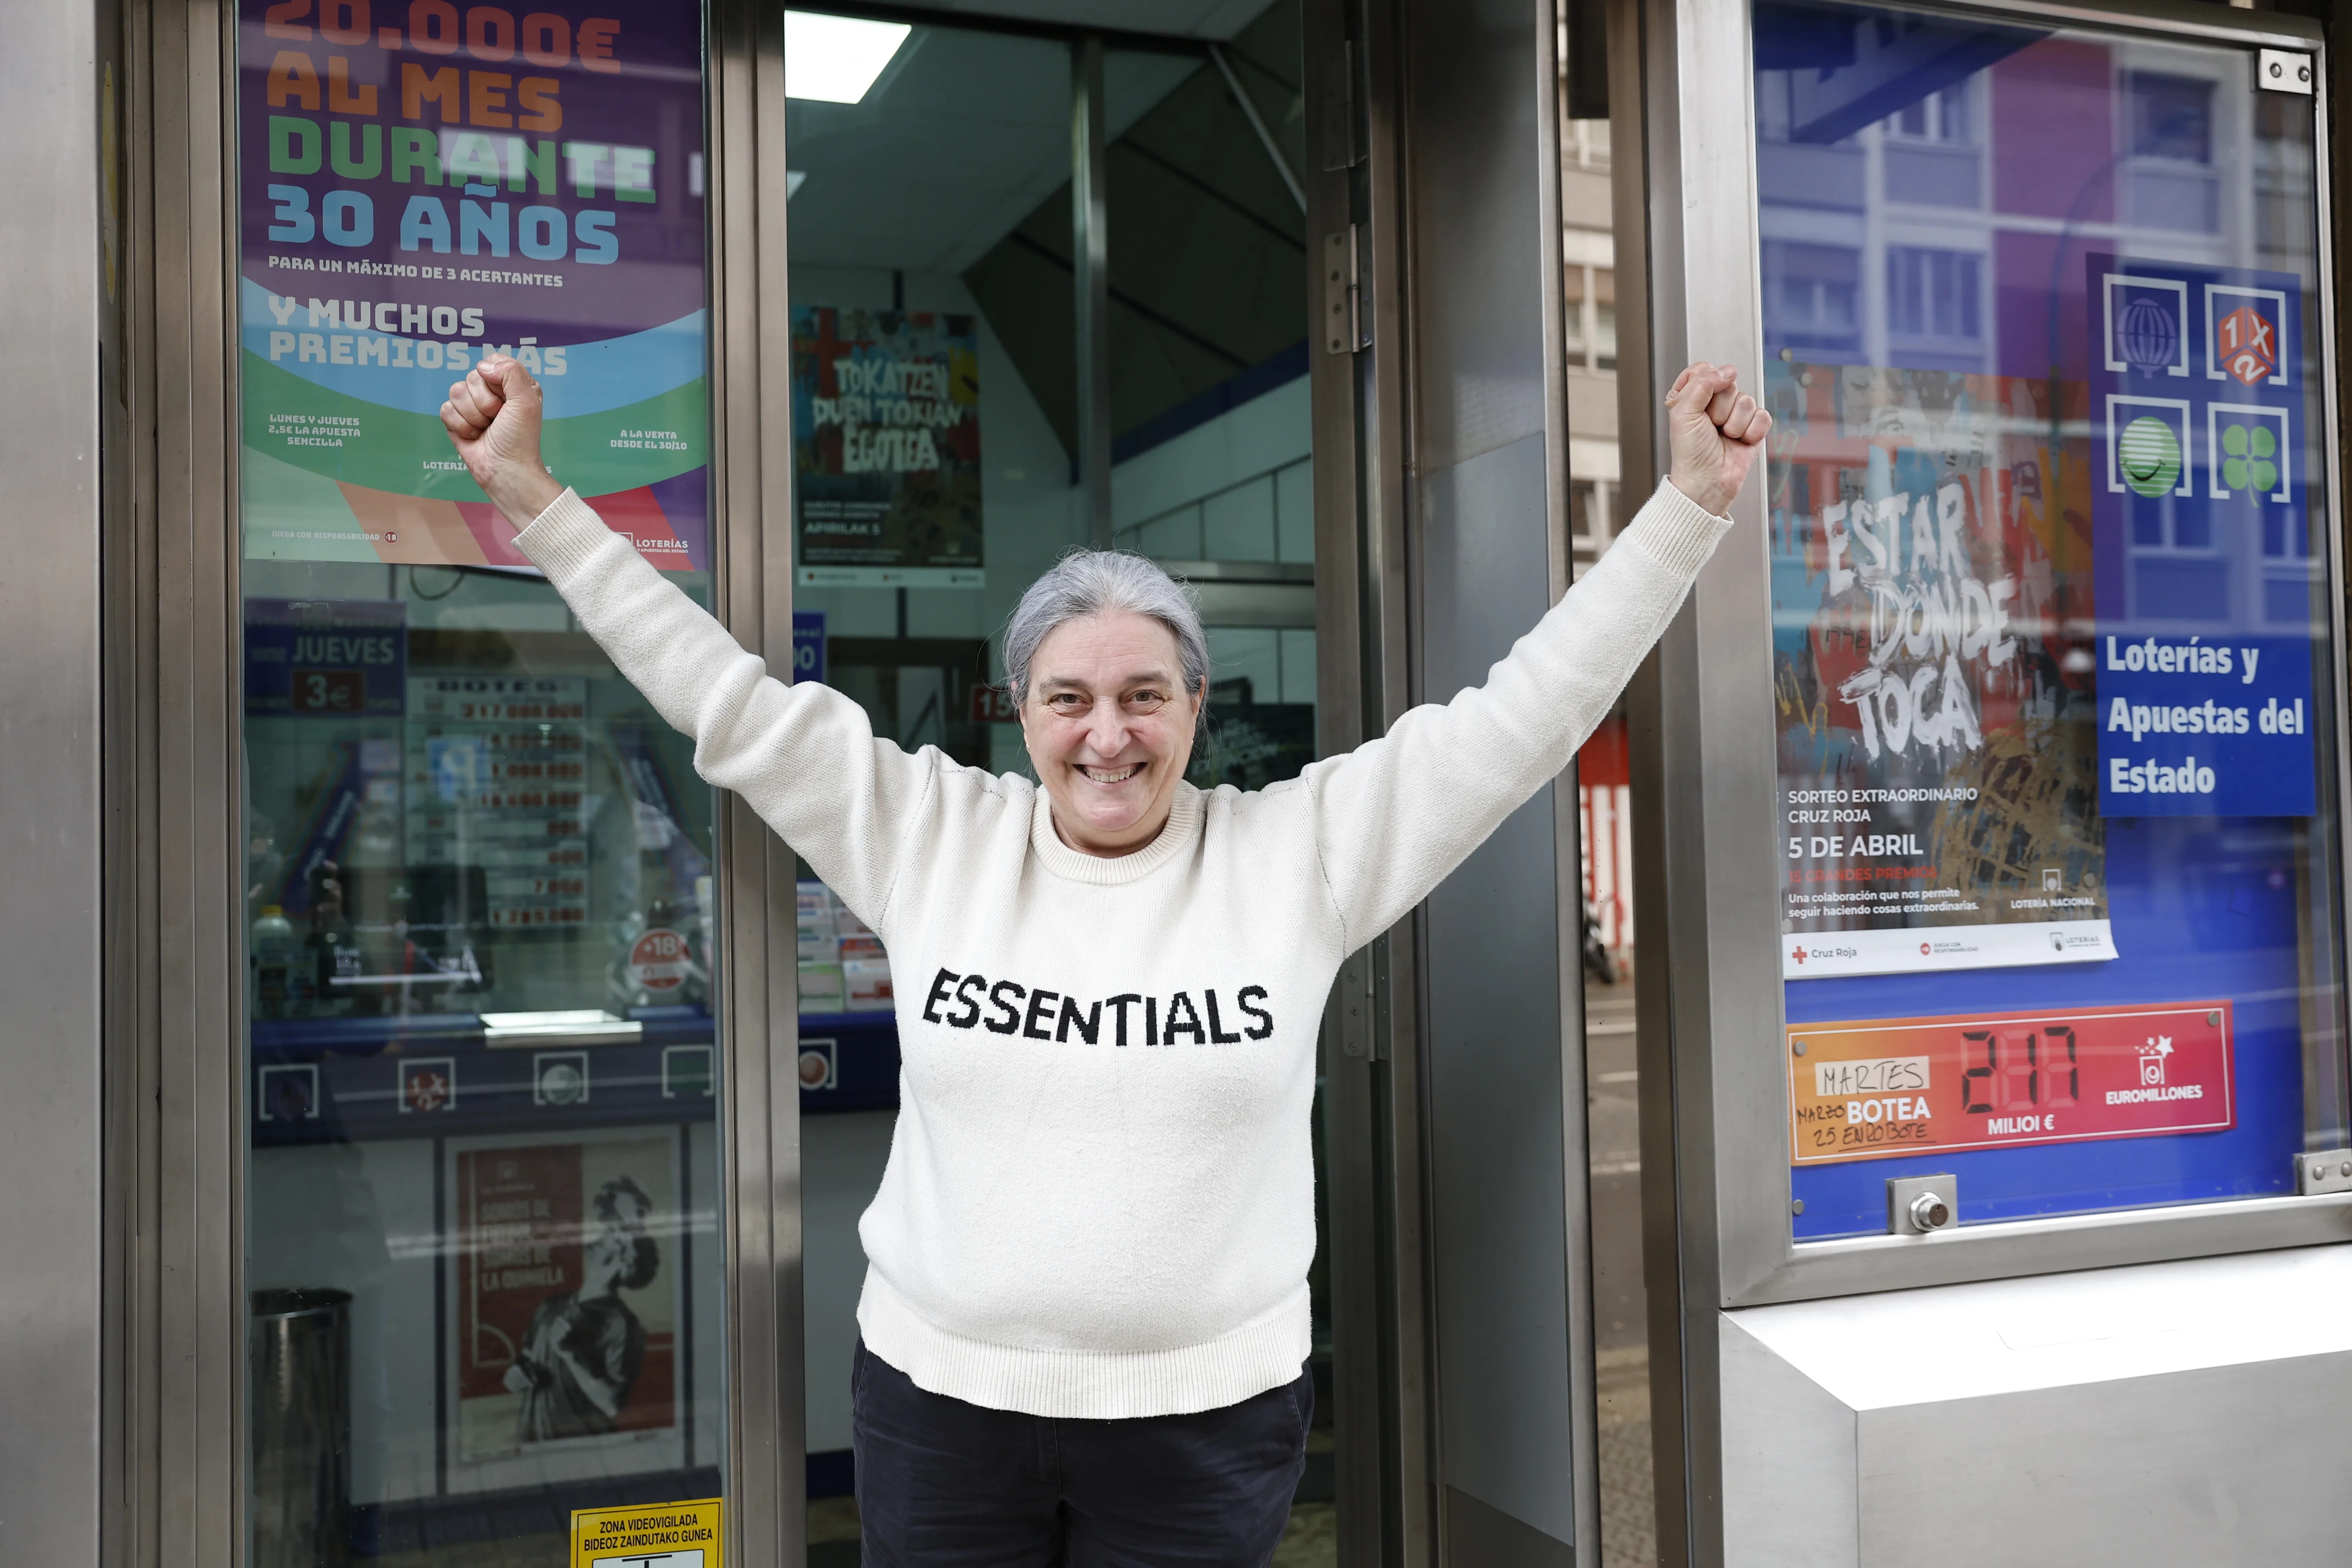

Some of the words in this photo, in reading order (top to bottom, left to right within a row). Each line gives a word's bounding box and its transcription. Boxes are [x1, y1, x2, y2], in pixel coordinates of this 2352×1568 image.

[267, 50, 378, 116] AL
[401, 62, 563, 133] MES
[269, 115, 656, 204] DURANTE
[268, 183, 374, 247] 30
[400, 183, 619, 265] AÑOS
[269, 255, 315, 271] PARA
[319, 259, 343, 273] UN
[347, 259, 418, 278] MÁXIMO
[422, 266, 443, 280] DE
[447, 268, 456, 281] 3
[460, 269, 563, 287] ACERTANTES
[269, 295, 296, 326] Y
[308, 298, 485, 337] MUCHOS
[269, 330, 470, 371] PREMIOS
[269, 425, 293, 434] 2,5€
[295, 426, 310, 435] LA
[312, 426, 361, 437] APUESTA
[270, 414, 306, 423] LUNES
[318, 416, 359, 426] JUEVES
[287, 437, 343, 447] SENCILLA
[610, 439, 643, 448] DESDE
[659, 441, 688, 450] 30/10
[620, 430, 627, 438] A
[645, 431, 677, 439] VENTA
[314, 532, 379, 541] RESPONSABILIDAD
[636, 538, 688, 548] LOTERÍAS
[1821, 481, 1973, 598] ESTAR
[1860, 571, 2018, 667] DONDE
[292, 636, 395, 664] JUEVES
[2107, 635, 2233, 674] Loterías
[2241, 648, 2259, 684] y
[1838, 651, 1983, 760] TOCA
[2107, 697, 2250, 742] Apuestas
[2258, 697, 2304, 735] del
[2110, 756, 2216, 793] Estado
[1788, 790, 1848, 804] SORTEO
[1852, 787, 1978, 803] EXTRAORDINARIO
[1788, 811, 1830, 824] CRUZ
[1833, 809, 1871, 823] ROJA
[1788, 837, 1803, 859] 5
[1810, 837, 1843, 857] DE
[1850, 833, 1924, 857] ABRIL
[1789, 871, 1801, 883] 15
[1805, 868, 1873, 882] GRANDES
[1876, 866, 1938, 880] PREMIOS
[1789, 894, 1809, 903] Una
[1811, 891, 1877, 902] colaboración
[1879, 891, 1899, 902] que
[1901, 889, 1920, 899] nos
[1922, 887, 1960, 900] permite
[2050, 897, 2096, 908] NACIONAL
[1788, 907, 1821, 920] seguir
[1823, 904, 1871, 916] haciendo
[1873, 904, 1902, 914] cosas
[1903, 900, 1980, 913] extraordinarias.
[1811, 947, 1833, 958] Cruz
[1836, 947, 1857, 958] Roja
[922, 967, 1274, 1047] ESSENTIALS
[1824, 1060, 1924, 1095] MARTES
[1961, 1025, 2078, 1114] 217
[2105, 1084, 2203, 1105] EUROMILLONES
[1797, 1105, 1845, 1125] MARZO
[1847, 1096, 1931, 1124] BOTEA
[1987, 1116, 2040, 1135] MILIOI
[2043, 1114, 2054, 1131] €
[1813, 1127, 1837, 1147] 25
[600, 1520, 626, 1534] ZONA
[628, 1514, 698, 1530] VIDEOVIGILADA
[584, 1537, 618, 1551] BIDEOZ
[620, 1531, 679, 1547] ZAINDUTAKO
[681, 1528, 713, 1541] GUNEA
